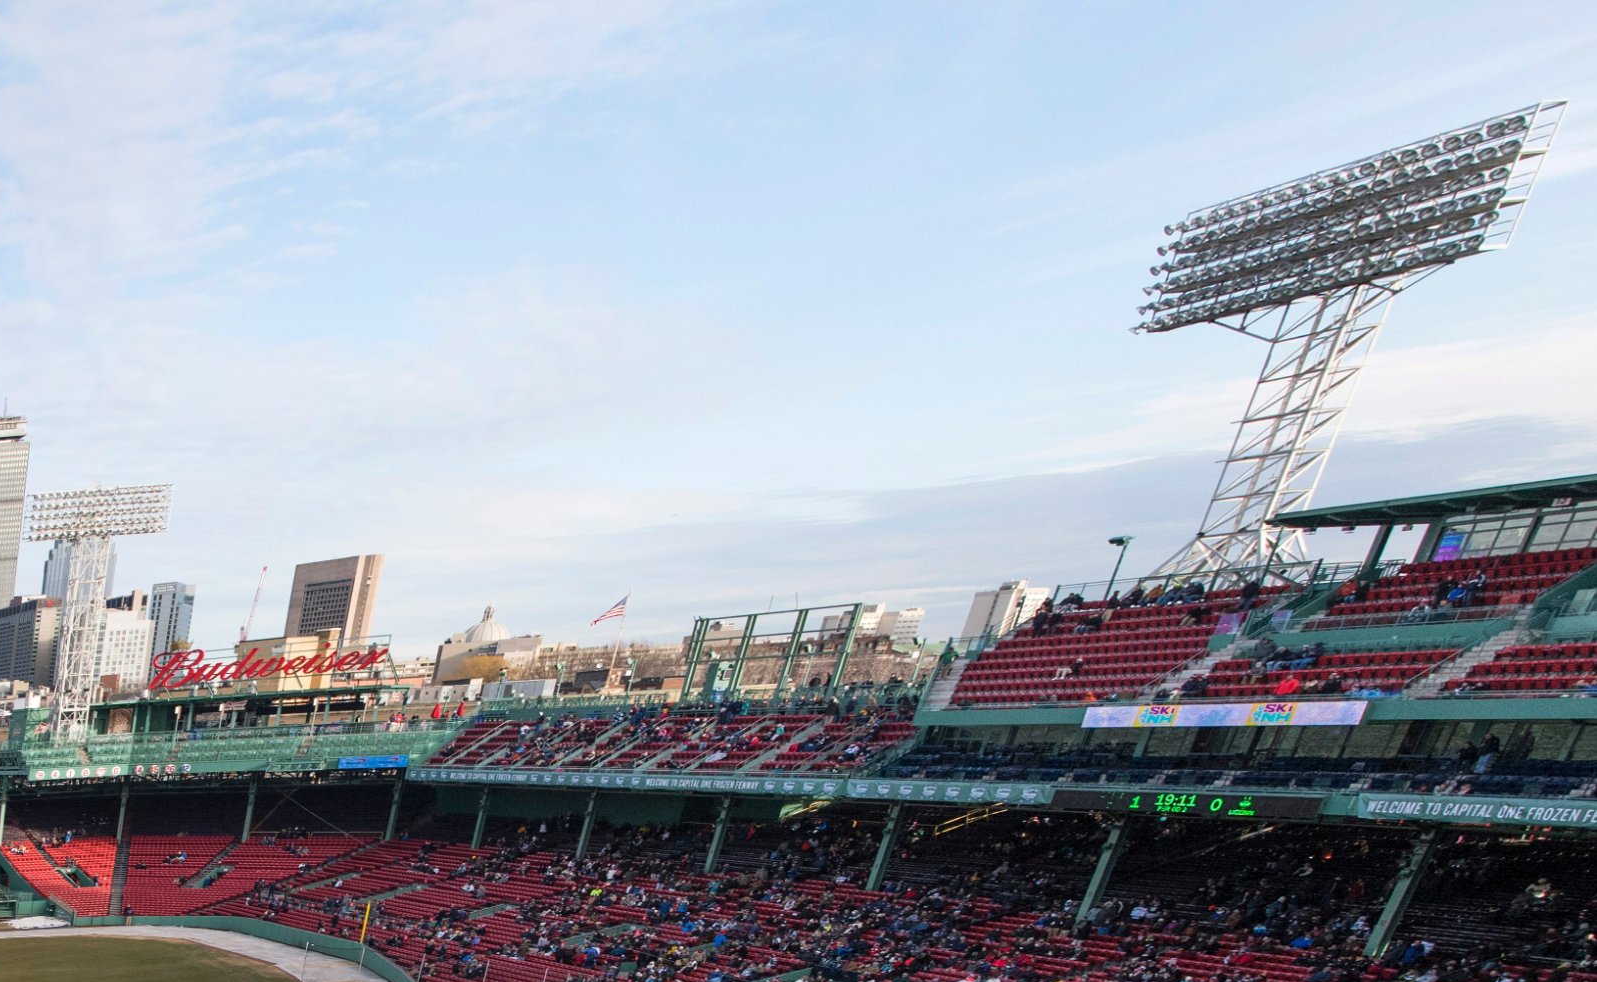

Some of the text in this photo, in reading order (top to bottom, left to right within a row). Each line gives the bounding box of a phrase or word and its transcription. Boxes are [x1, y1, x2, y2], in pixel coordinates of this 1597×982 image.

[149, 642, 389, 690] Budweiser
[646, 778, 670, 787] WELCOME
[679, 779, 700, 788] CAPITAL
[701, 780, 712, 788] ONE
[713, 780, 735, 789] FROZEN
[735, 781, 759, 790] FENWAY
[1128, 796, 1141, 808] 1
[1154, 793, 1197, 807] 19:11
[1209, 798, 1223, 811] 0
[1366, 800, 1585, 822] WELCOME TO CAPITAL ONE FROZEN
